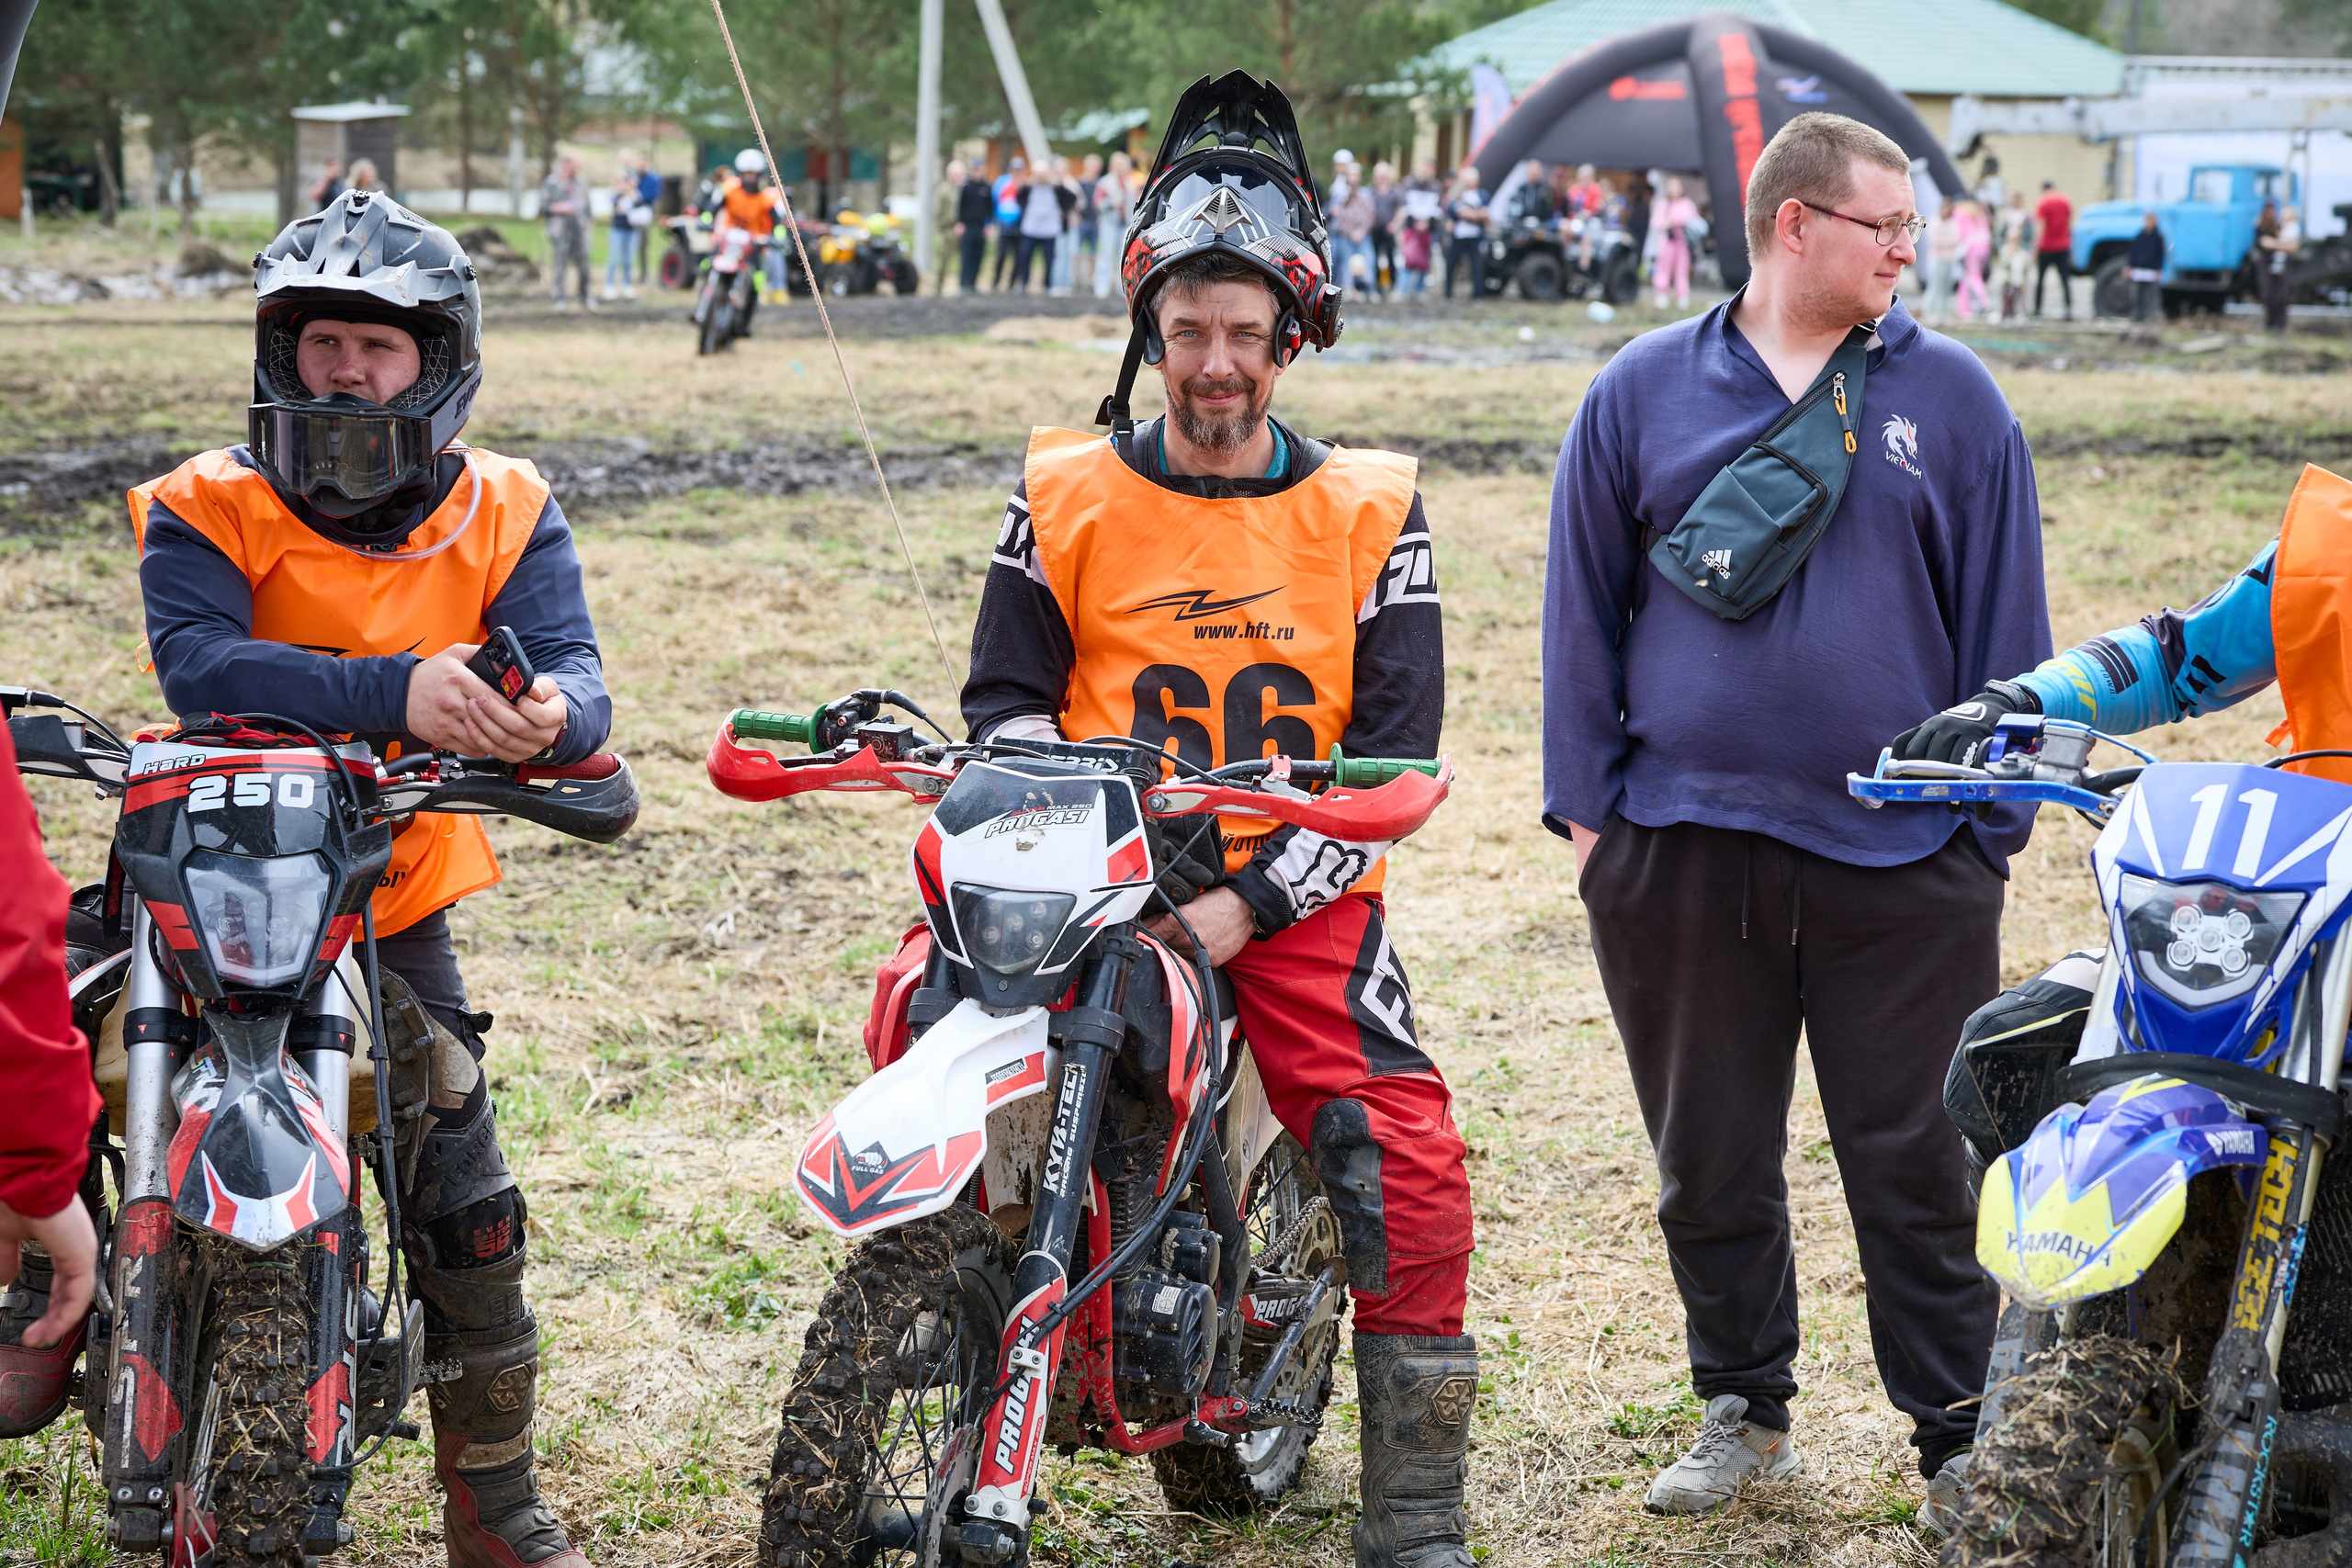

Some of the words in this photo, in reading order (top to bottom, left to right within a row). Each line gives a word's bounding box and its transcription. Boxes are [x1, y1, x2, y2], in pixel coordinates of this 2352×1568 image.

[1886, 450, 1922, 479] VIETNAM
[1702, 554, 1731, 580] adidas
[1193, 622, 1295, 641] www.hft.ru
[1130, 662, 1317, 794] 66
[187, 773, 315, 813] 250
[984, 810, 1090, 839] PROGASI
[2181, 784, 2278, 880] 11
[869, 1167, 884, 1175] GAS
[2250, 1137, 2298, 1243] TECH
[2007, 1231, 2111, 1268] YAMAHA
[1029, 1441, 1038, 1463] MAX
